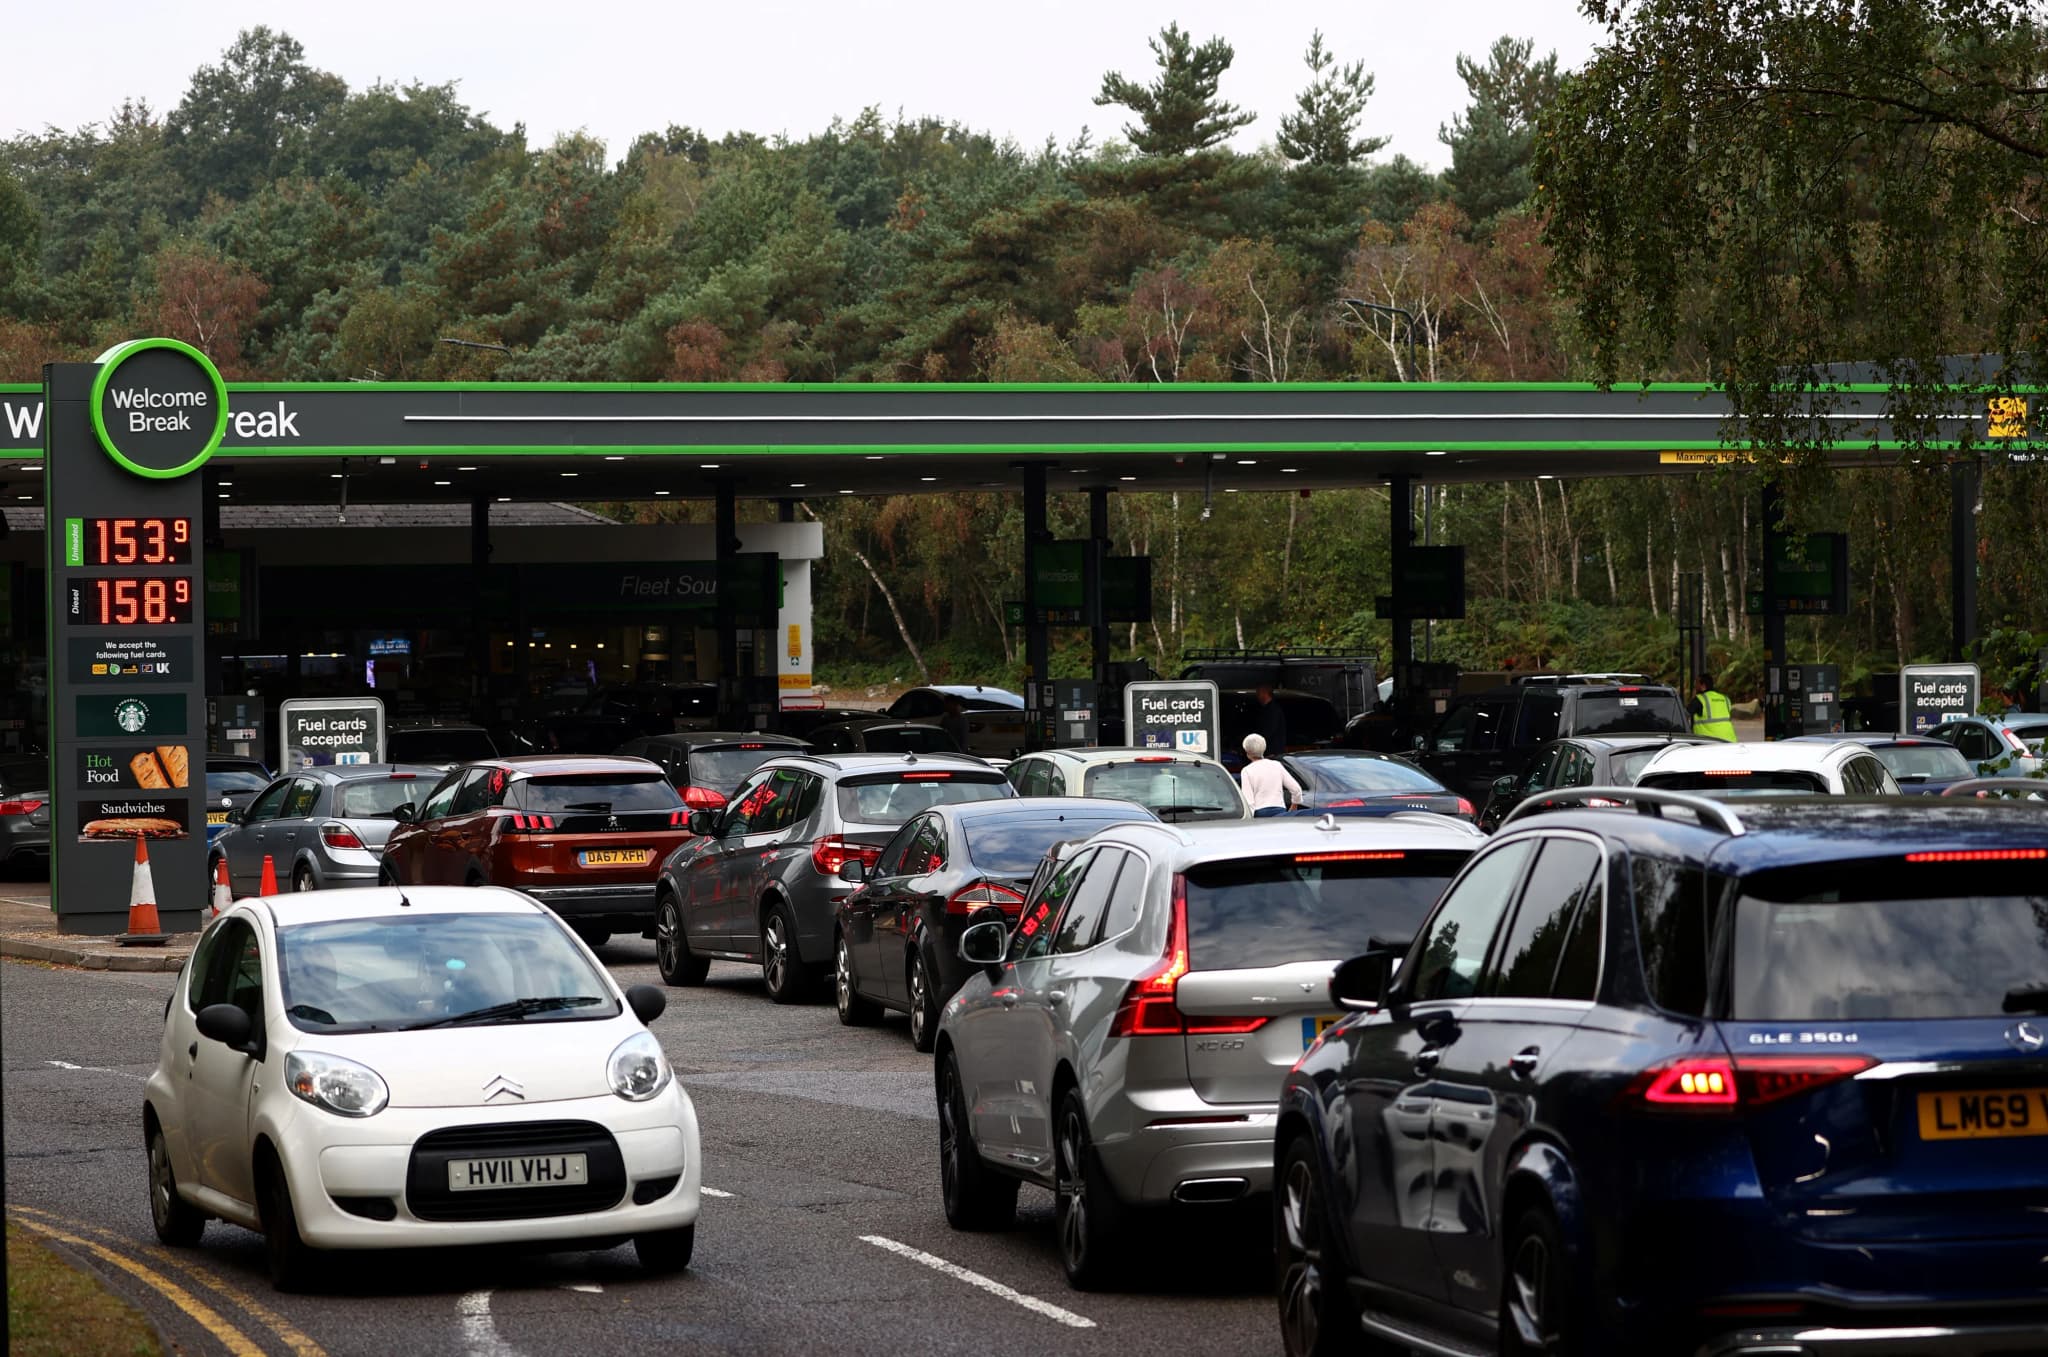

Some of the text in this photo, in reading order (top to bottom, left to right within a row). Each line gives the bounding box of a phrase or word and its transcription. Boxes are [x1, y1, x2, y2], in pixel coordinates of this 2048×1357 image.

[111, 388, 207, 409] Welcome
[129, 411, 191, 432] Break
[71, 524, 79, 562] Unleaded
[620, 575, 671, 595] Fleet
[72, 589, 80, 614] Diesel
[1013, 607, 1021, 620] 3
[118, 642, 143, 650] accept
[144, 641, 157, 649] the
[96, 652, 129, 660] following
[130, 651, 145, 659] fuel
[156, 662, 171, 674] UK
[1914, 682, 1968, 694] Fuel cards
[1142, 697, 1205, 710] Fuel cards
[1916, 695, 1964, 708] accepted
[298, 717, 367, 731] Fuel cards
[1145, 711, 1202, 725] accepted
[302, 732, 363, 748] accepted
[1182, 732, 1201, 746] UK
[87, 755, 113, 768] Hot
[86, 769, 120, 783] Food
[101, 802, 166, 814] Sandwiches
[588, 849, 645, 863] DA67 XFH
[1749, 1032, 1858, 1044] GLE 350d
[1934, 1094, 2030, 1131] LM69
[468, 1157, 567, 1185] HV11 VHJ
